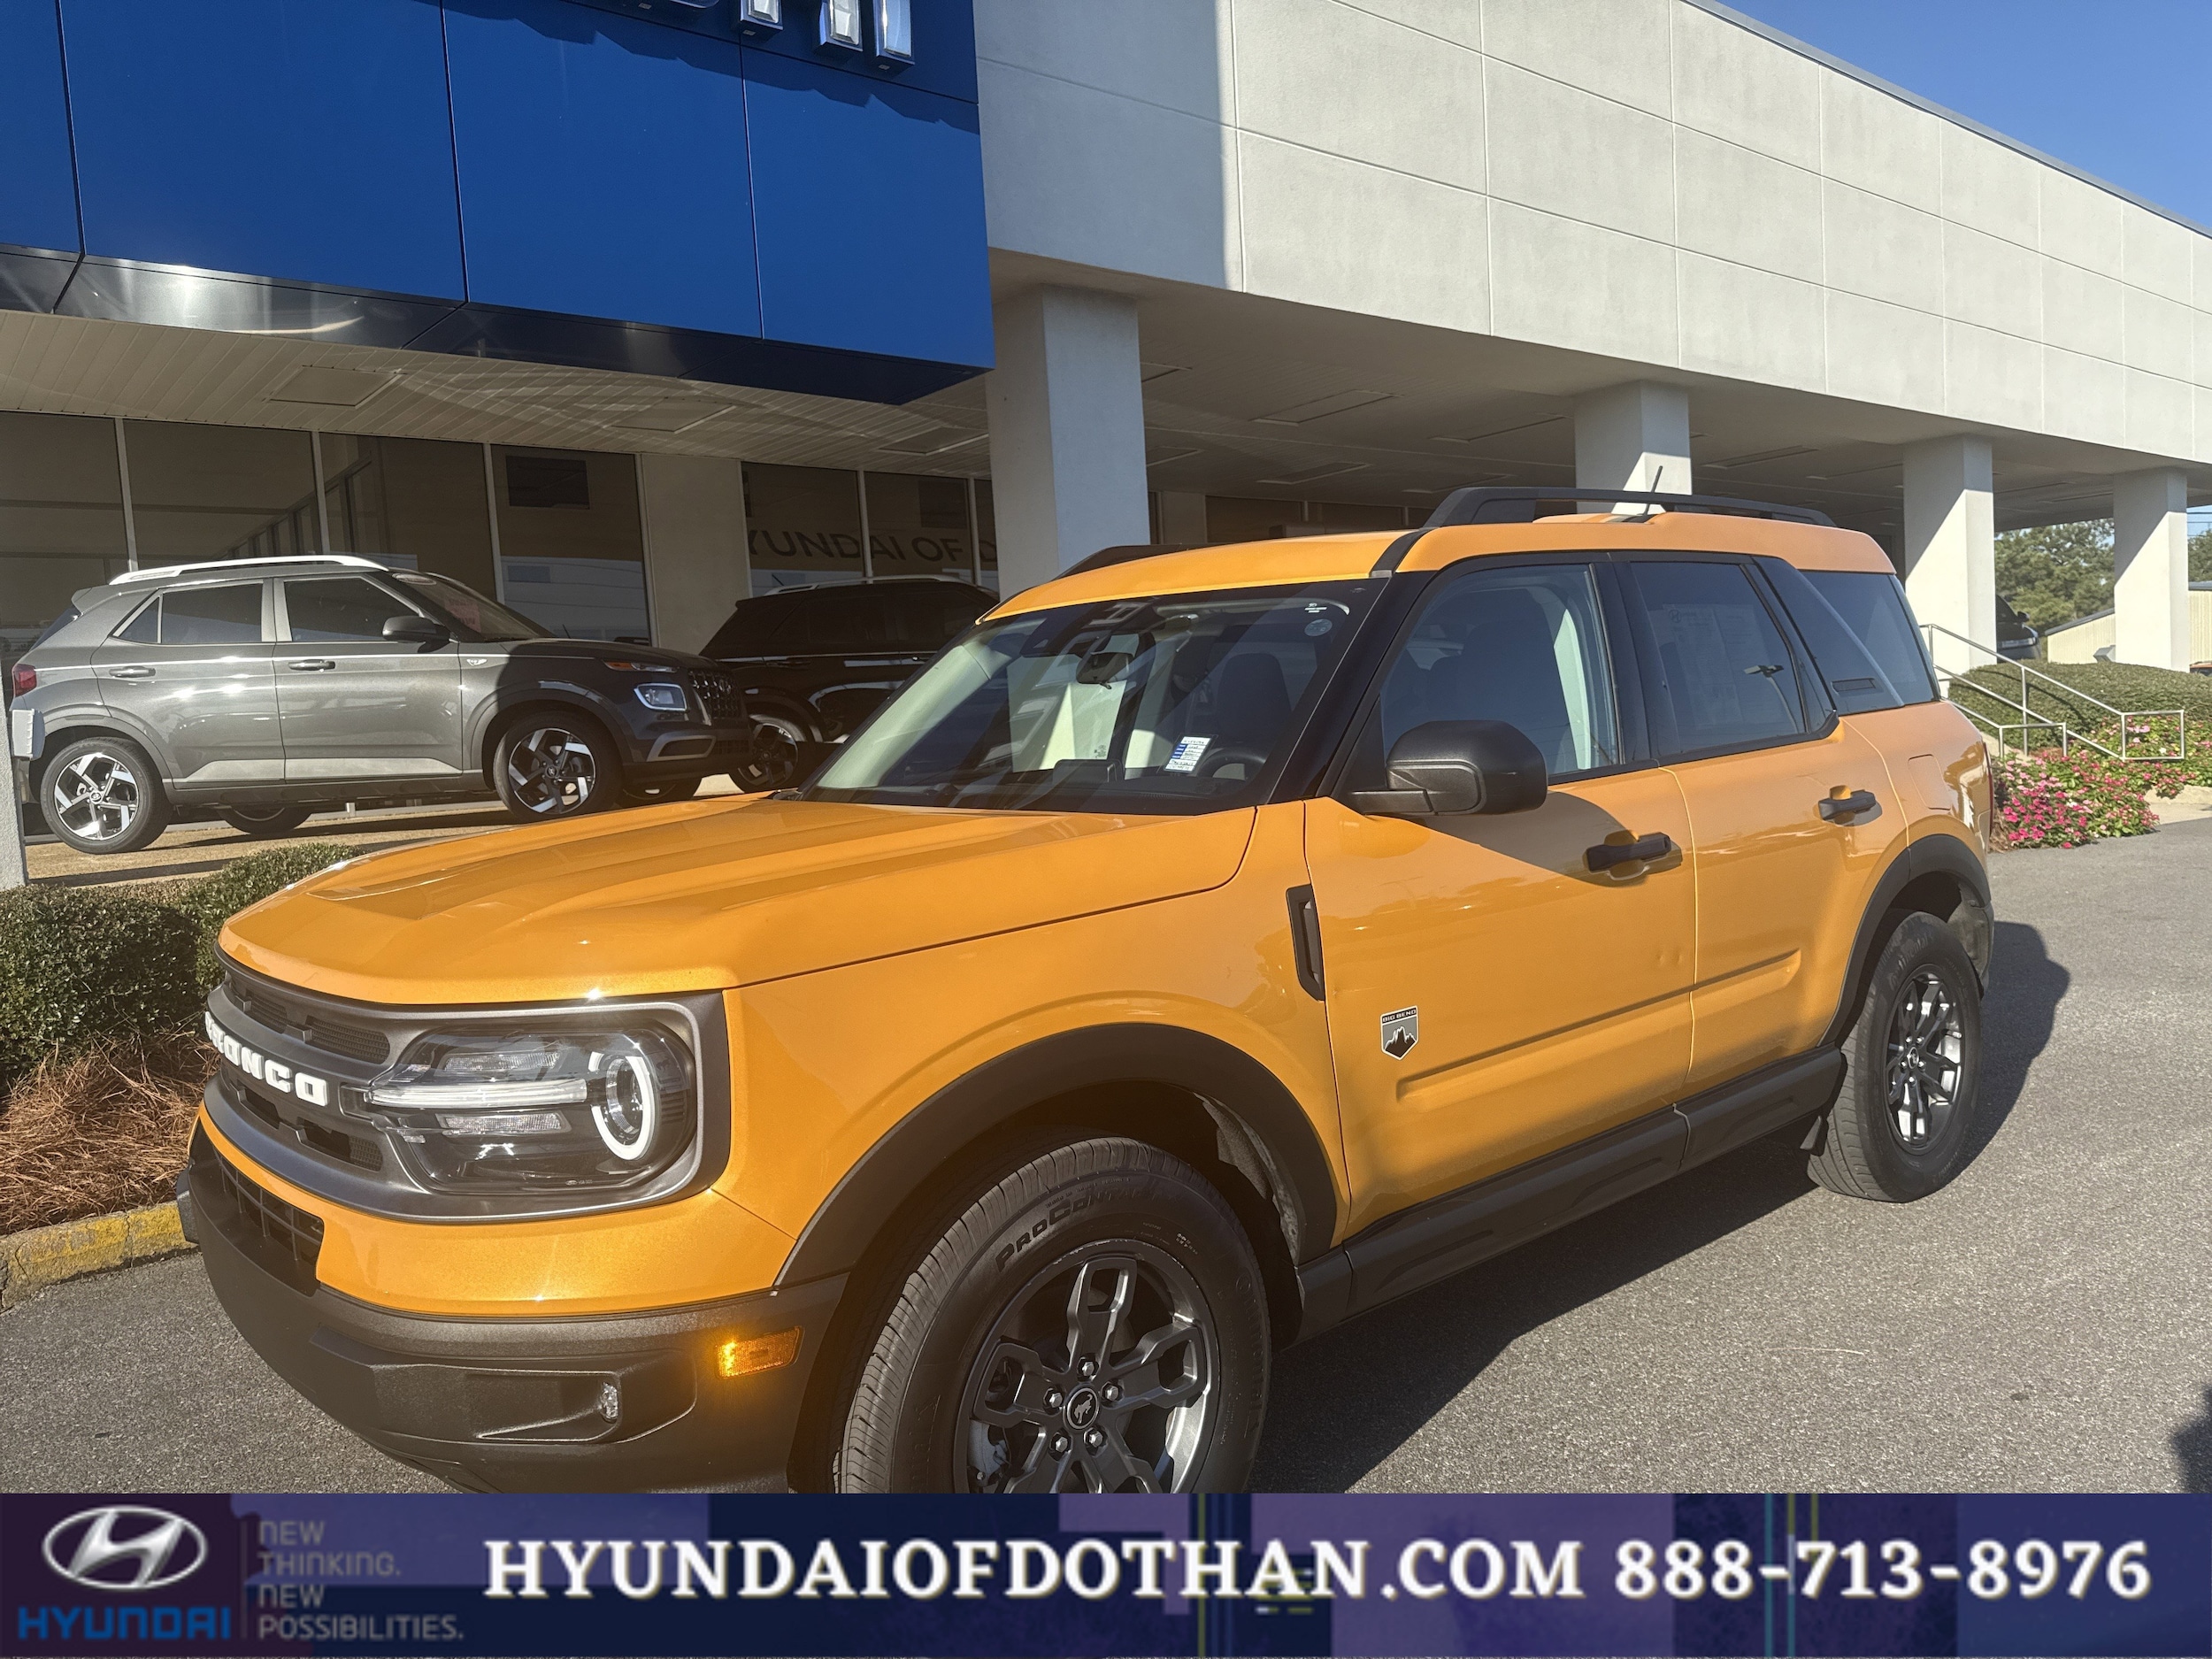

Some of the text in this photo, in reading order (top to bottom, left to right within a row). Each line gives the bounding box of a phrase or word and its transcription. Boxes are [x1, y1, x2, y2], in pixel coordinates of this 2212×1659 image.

[911, 536, 964, 562] OF
[1382, 1009, 1417, 1023] BIG BEND
[204, 1010, 329, 1107] BRONCO
